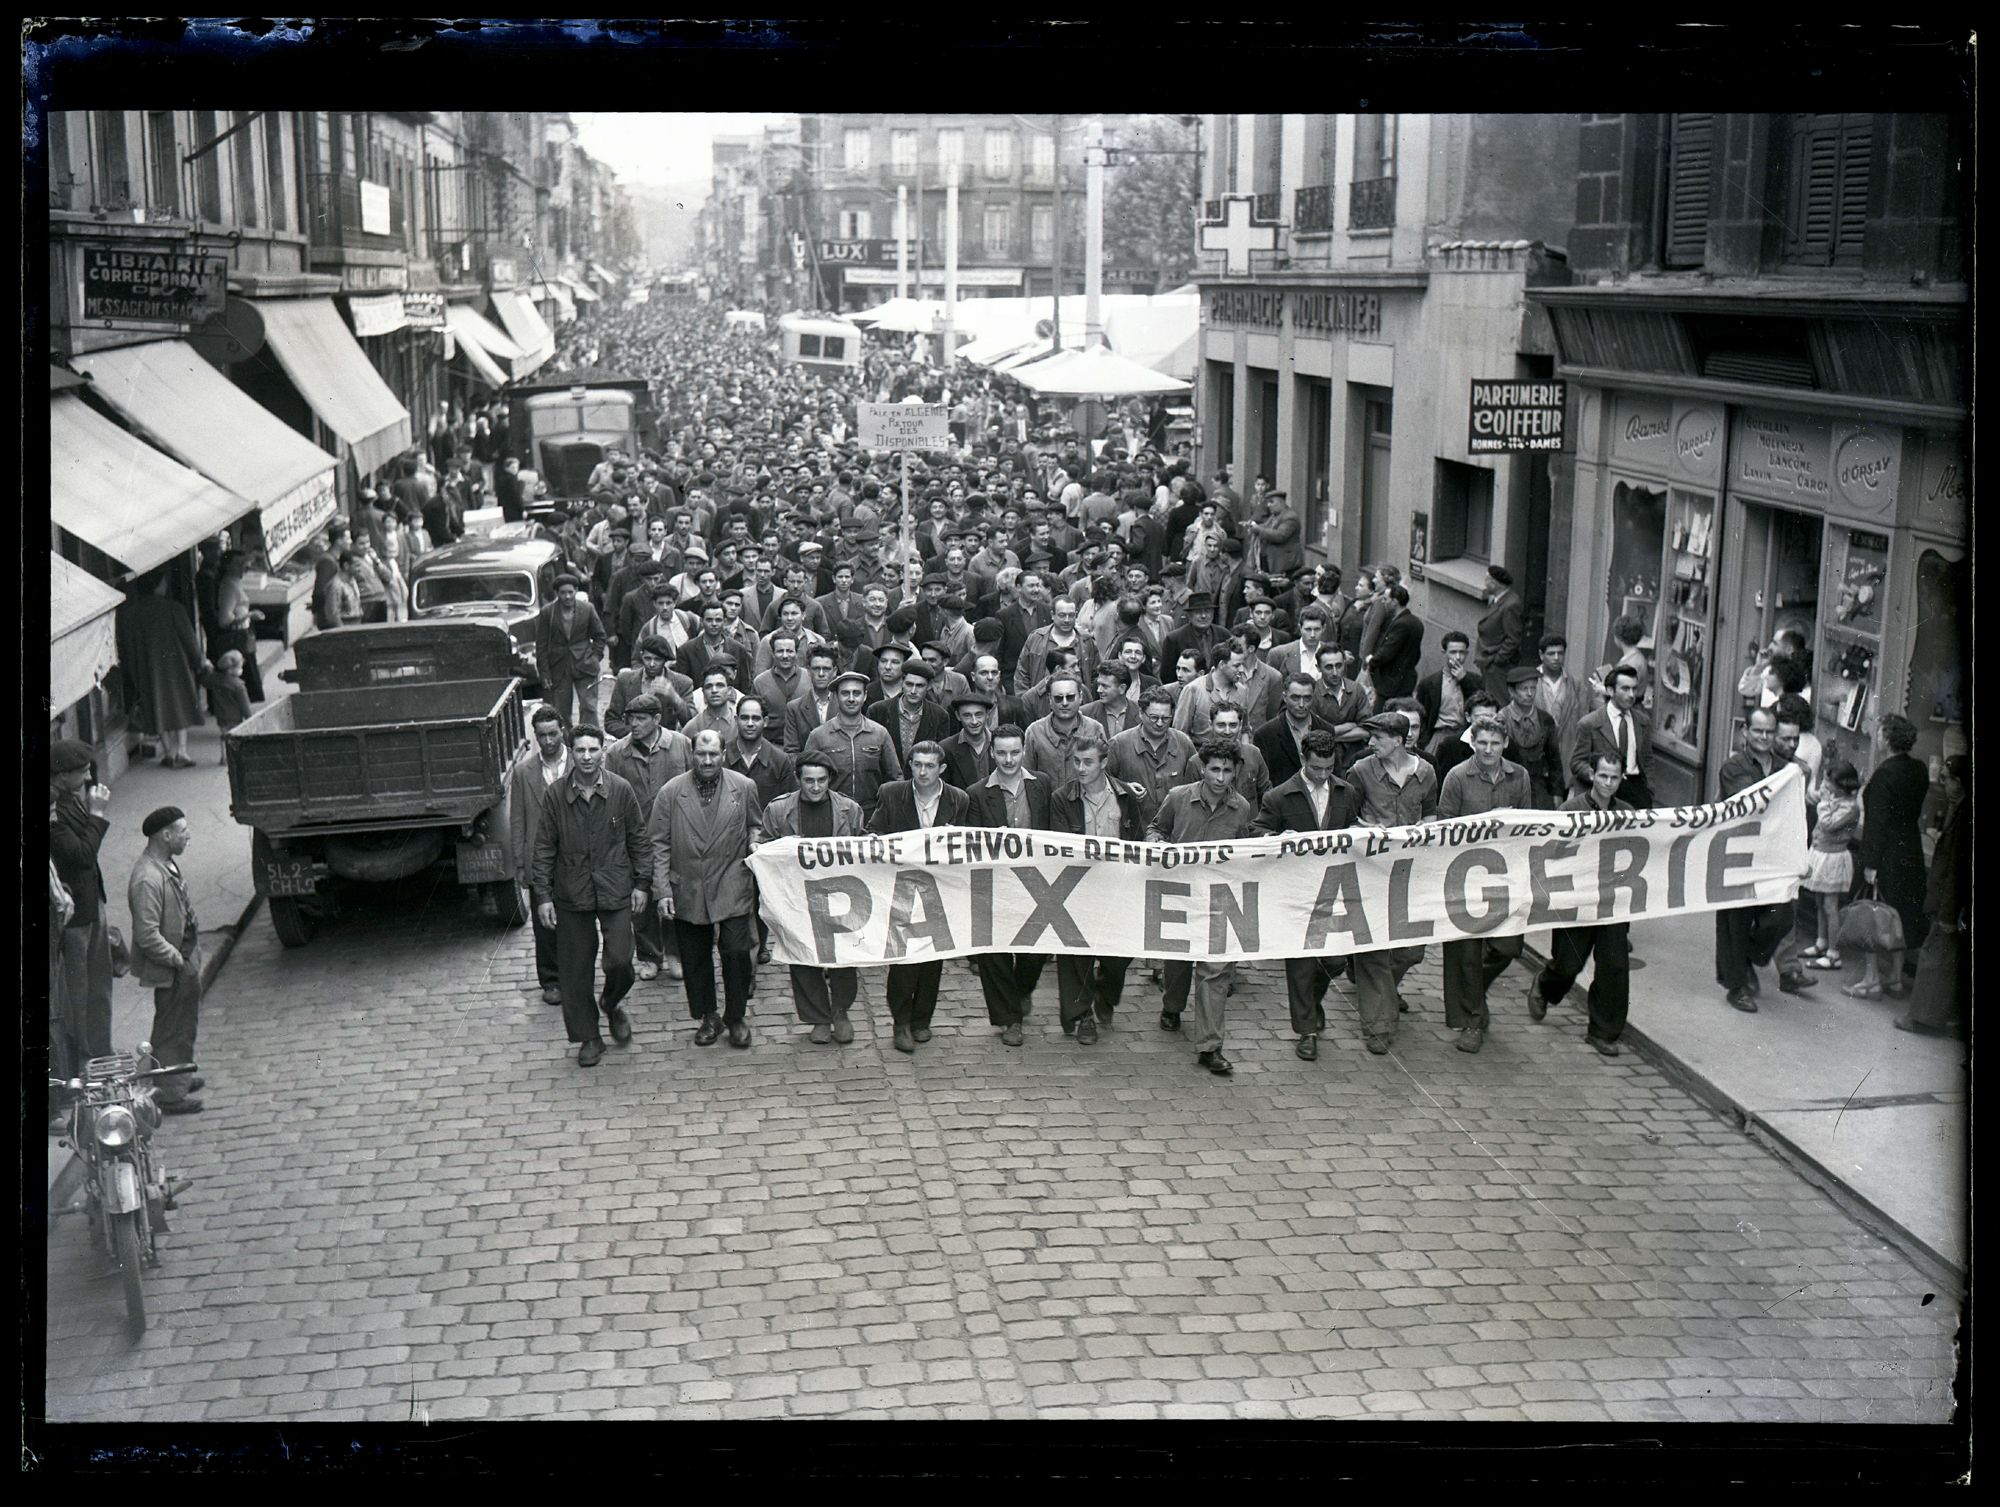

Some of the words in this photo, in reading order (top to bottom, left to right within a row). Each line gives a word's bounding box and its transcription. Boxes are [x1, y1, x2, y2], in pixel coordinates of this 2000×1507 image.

[822, 243, 863, 260] LUX
[1211, 291, 1284, 328] PHARMACIE
[1292, 293, 1381, 334] MOULINIER
[1473, 385, 1563, 406] PARFUMERIE
[900, 427, 918, 435] DES
[1473, 409, 1562, 436] COIFFEUR
[1625, 414, 1670, 441] Dames
[875, 434, 945, 448] DISPONIBLES
[1472, 439, 1502, 450] HOMMES
[1530, 438, 1561, 449] DAMES
[1678, 426, 1717, 460] YARDLEY
[1758, 433, 1805, 454] MOLYNEUX
[1796, 473, 1829, 493] CARON
[798, 835, 903, 871] CONTRE
[924, 831, 1034, 866] L'ENVOI
[1044, 844, 1074, 859] DE
[1280, 834, 1353, 859] POUR
[1366, 831, 1390, 857] LE
[1402, 820, 1504, 849] RETOUR
[1511, 822, 1552, 838] DES
[804, 864, 1091, 964] PAIX
[1143, 878, 1262, 955] EN
[1303, 820, 1762, 950] ALGÉRIE
